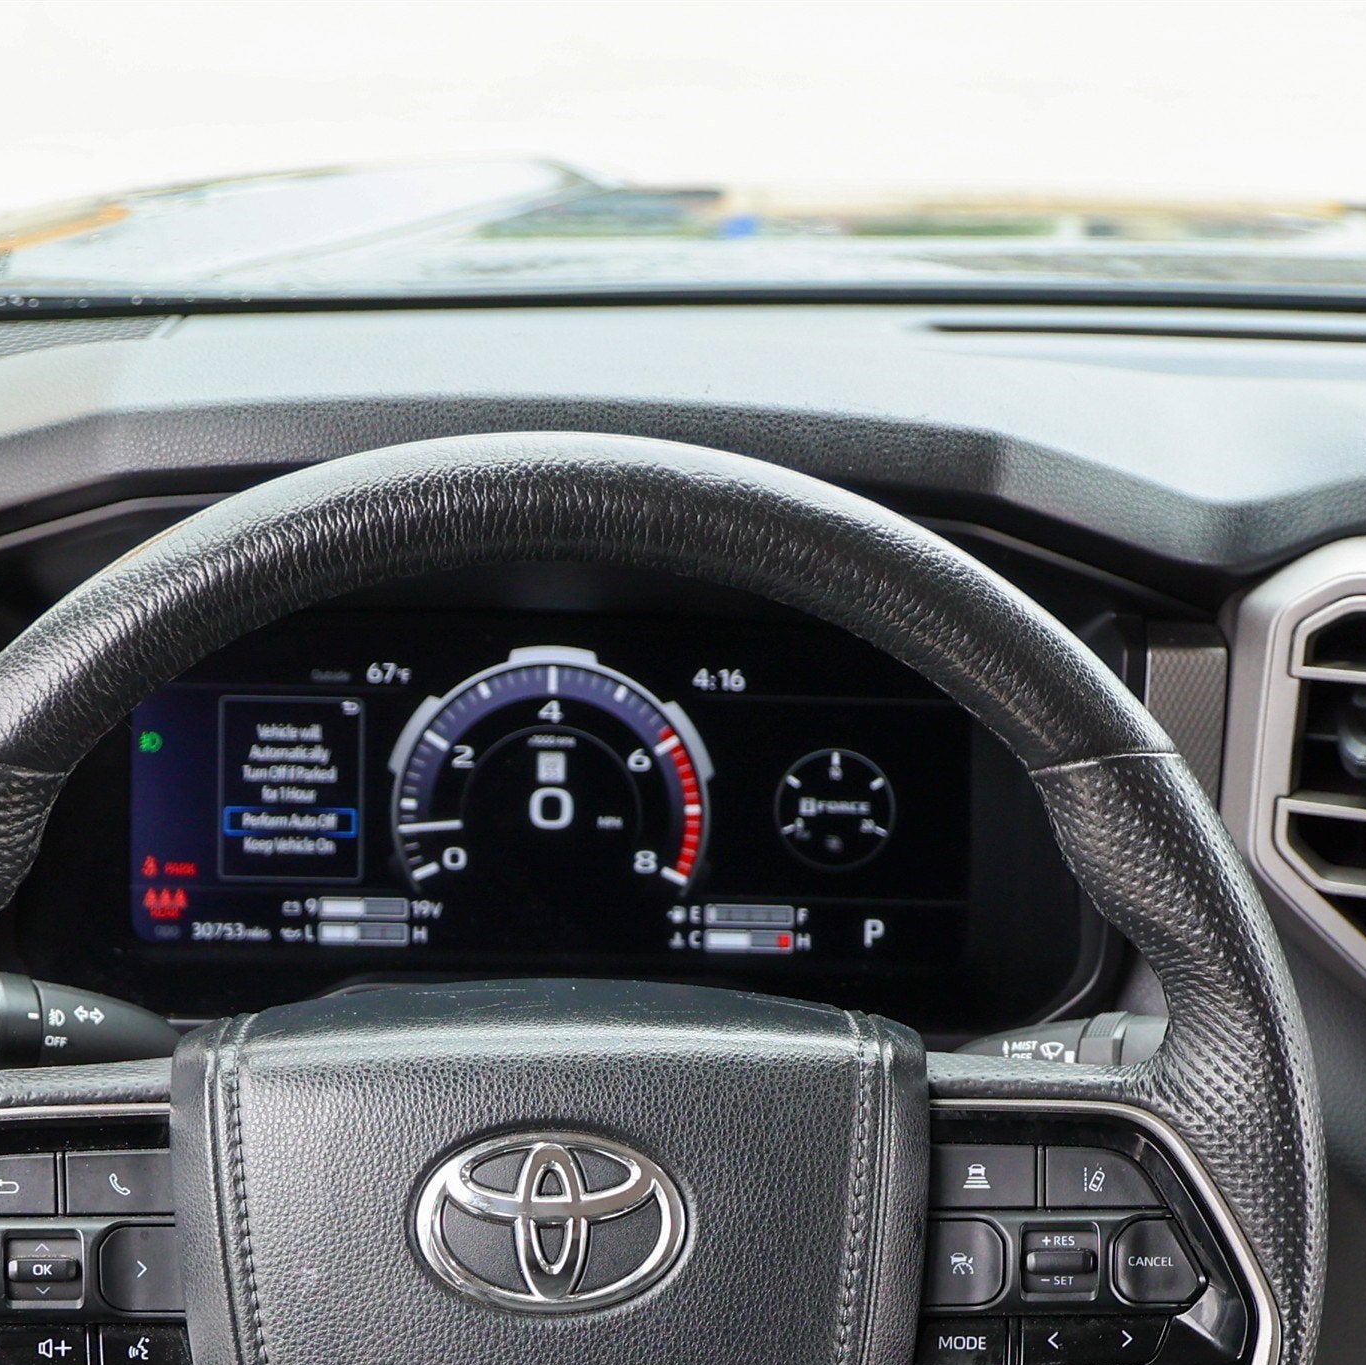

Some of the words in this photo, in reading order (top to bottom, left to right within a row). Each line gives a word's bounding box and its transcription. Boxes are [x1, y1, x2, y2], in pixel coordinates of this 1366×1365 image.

[692, 667, 746, 691] 4:16
[537, 700, 563, 723] 4
[256, 723, 298, 741] Vehicle
[299, 723, 322, 741] will
[248, 744, 331, 765] Automatically
[452, 745, 474, 768] 2
[627, 749, 651, 772] 6
[242, 764, 267, 781] Turn
[295, 765, 337, 783] Parked
[261, 785, 278, 803] for
[286, 786, 316, 803] Hour
[529, 787, 574, 830] 0
[242, 812, 288, 829] Perform
[289, 813, 316, 830] Auto
[316, 813, 337, 831] Off
[243, 837, 273, 856] Keep
[274, 836, 315, 855] Vehicle
[316, 837, 336, 855] On
[442, 847, 467, 870] 0
[634, 850, 658, 874] 8
[304, 899, 317, 914] 9
[689, 907, 701, 923] E
[796, 908, 809, 924] F
[191, 921, 245, 940] 30753
[304, 924, 314, 939] L
[412, 926, 428, 942] H
[688, 931, 702, 948] C
[796, 933, 811, 949] H
[863, 919, 884, 948] P
[45, 1034, 67, 1048] OFF
[1011, 1040, 1038, 1051] MIST
[33, 1264, 53, 1276] OK
[1128, 1256, 1174, 1268] CANCEL
[938, 1336, 987, 1351] MODE
